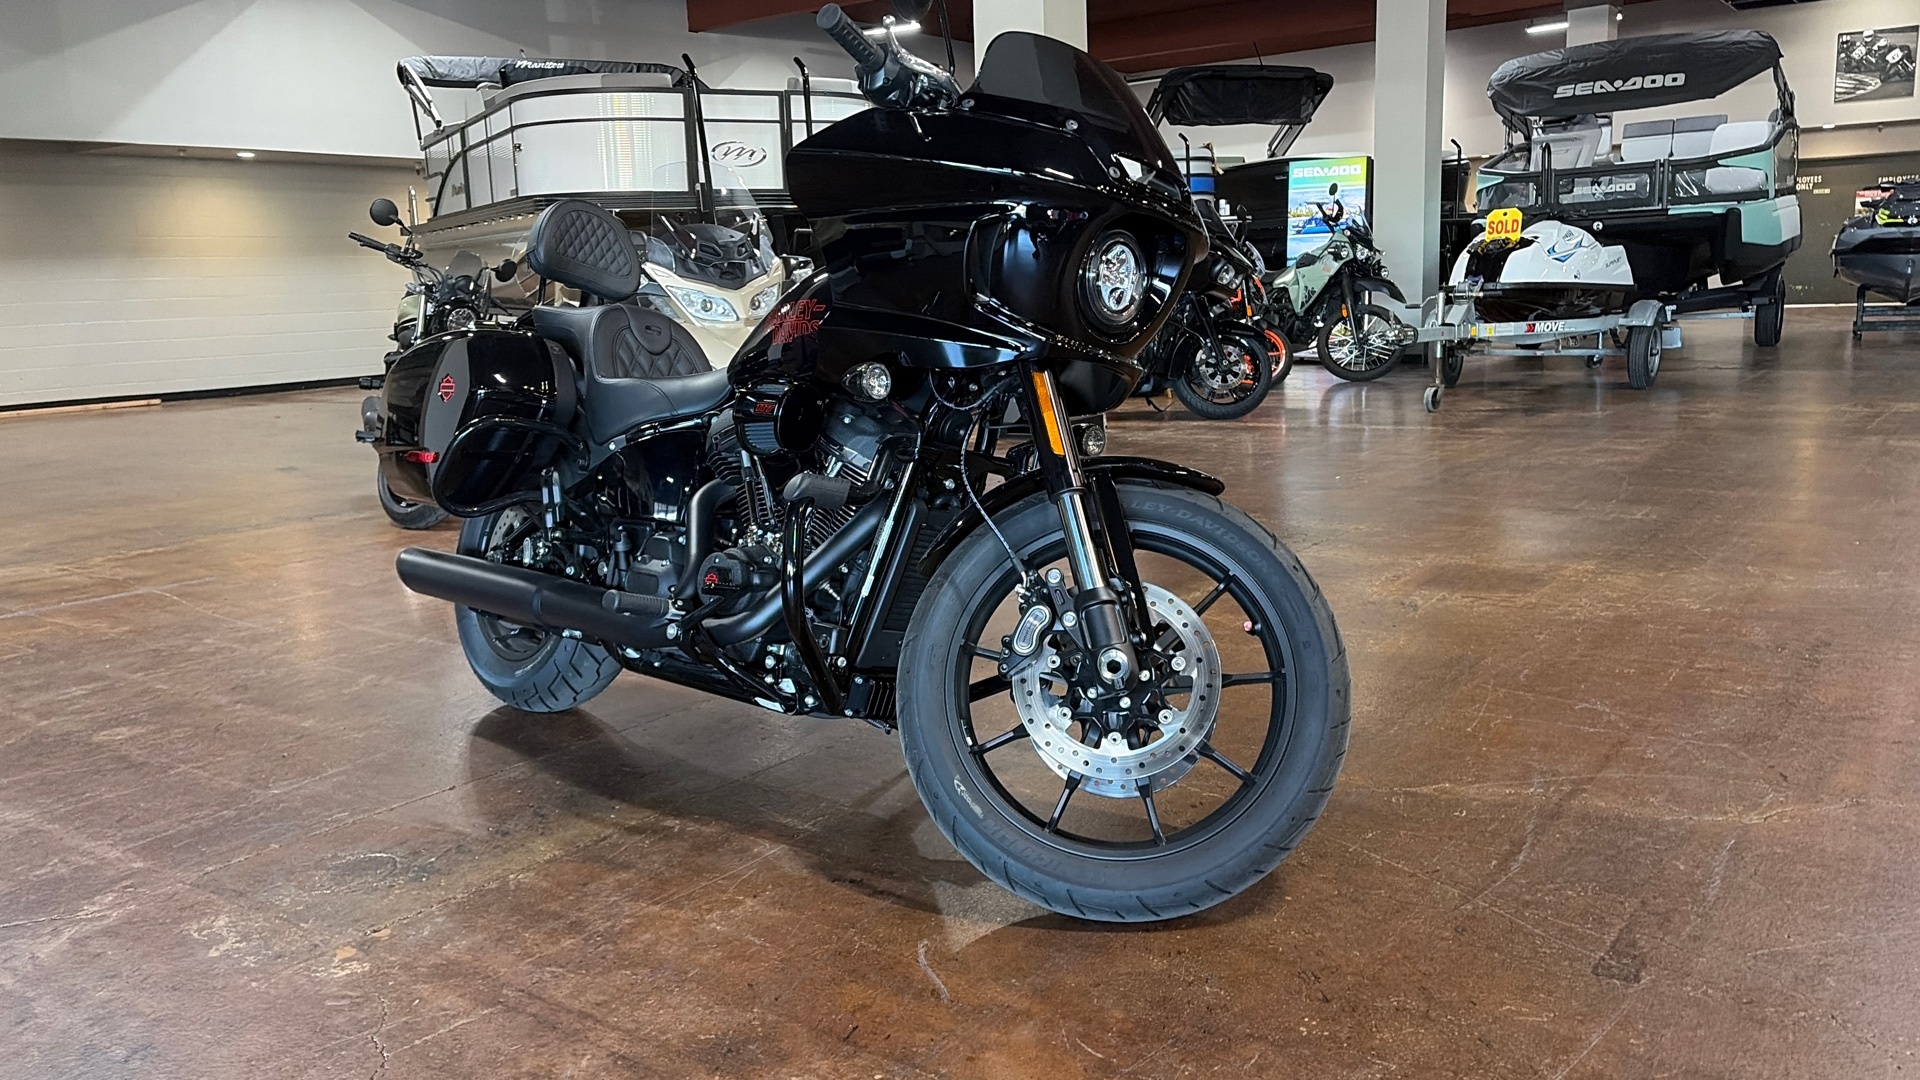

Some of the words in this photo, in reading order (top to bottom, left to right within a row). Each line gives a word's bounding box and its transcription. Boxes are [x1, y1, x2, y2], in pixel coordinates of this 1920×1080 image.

[1795, 182, 1814, 191] ONLY
[1487, 218, 1520, 235] SOLD
[1534, 321, 1566, 334] MOVE
